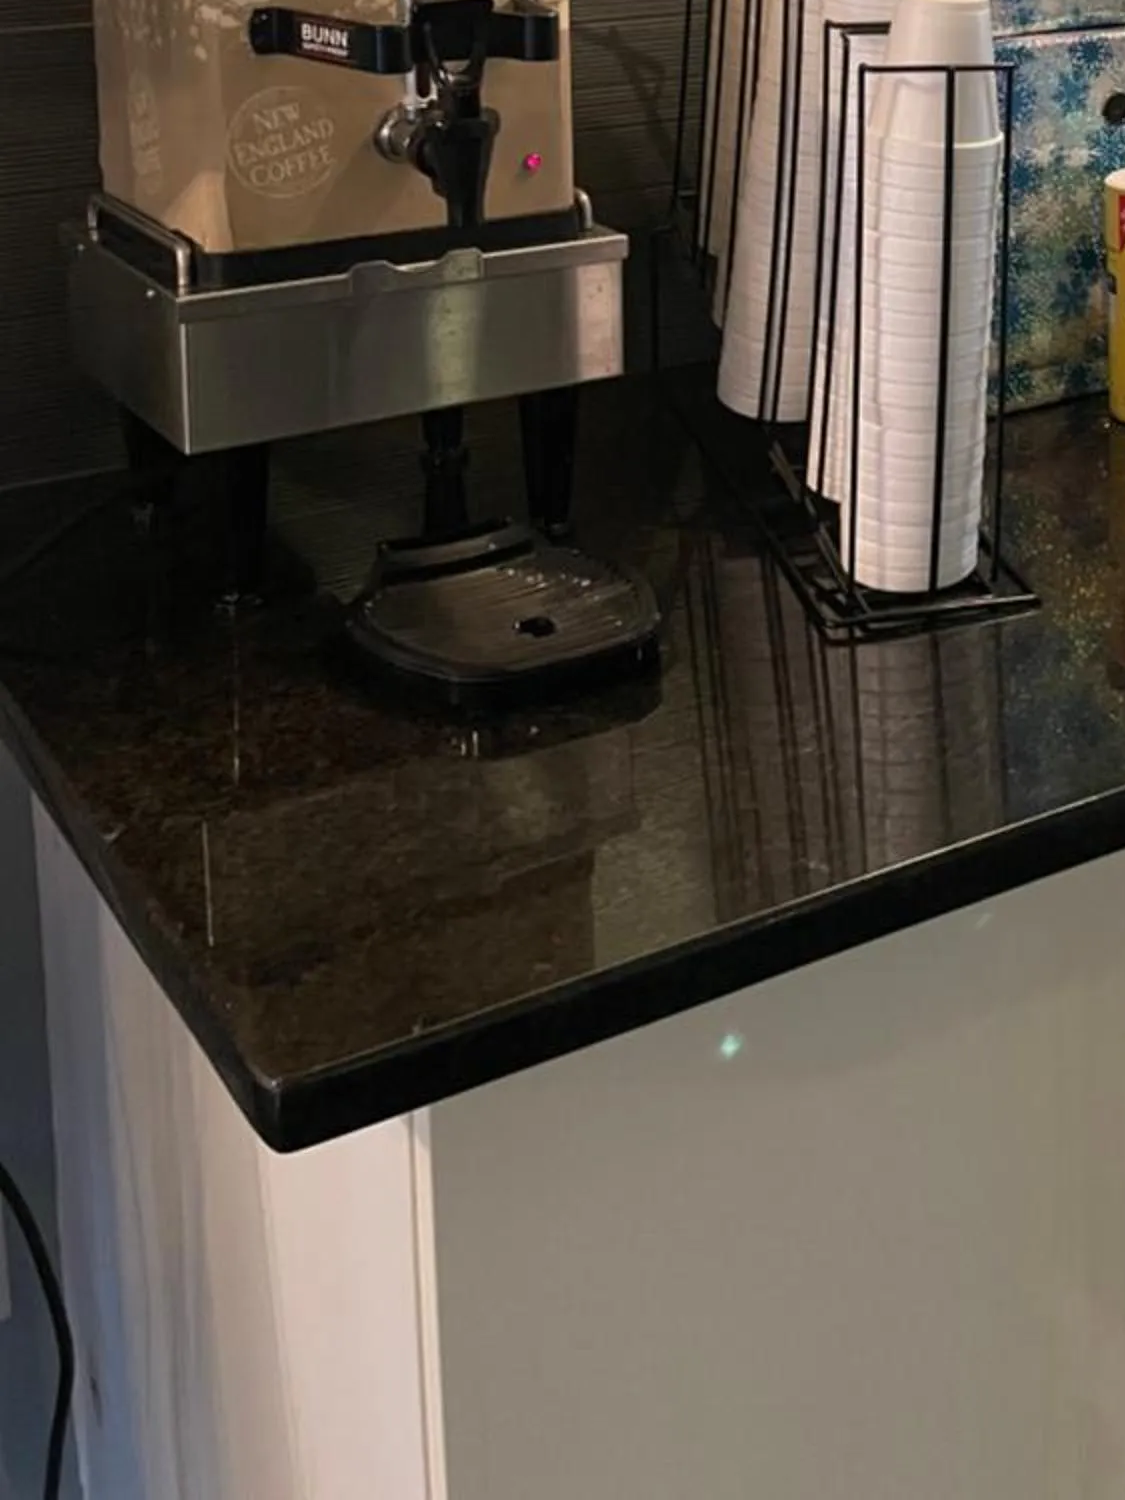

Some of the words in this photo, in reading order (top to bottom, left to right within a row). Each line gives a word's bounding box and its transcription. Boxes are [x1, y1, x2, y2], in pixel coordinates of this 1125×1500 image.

[301, 22, 348, 48] BUNN
[253, 102, 300, 133] NEW
[233, 118, 335, 166] ENGLAND
[249, 144, 337, 187] COFFEE
